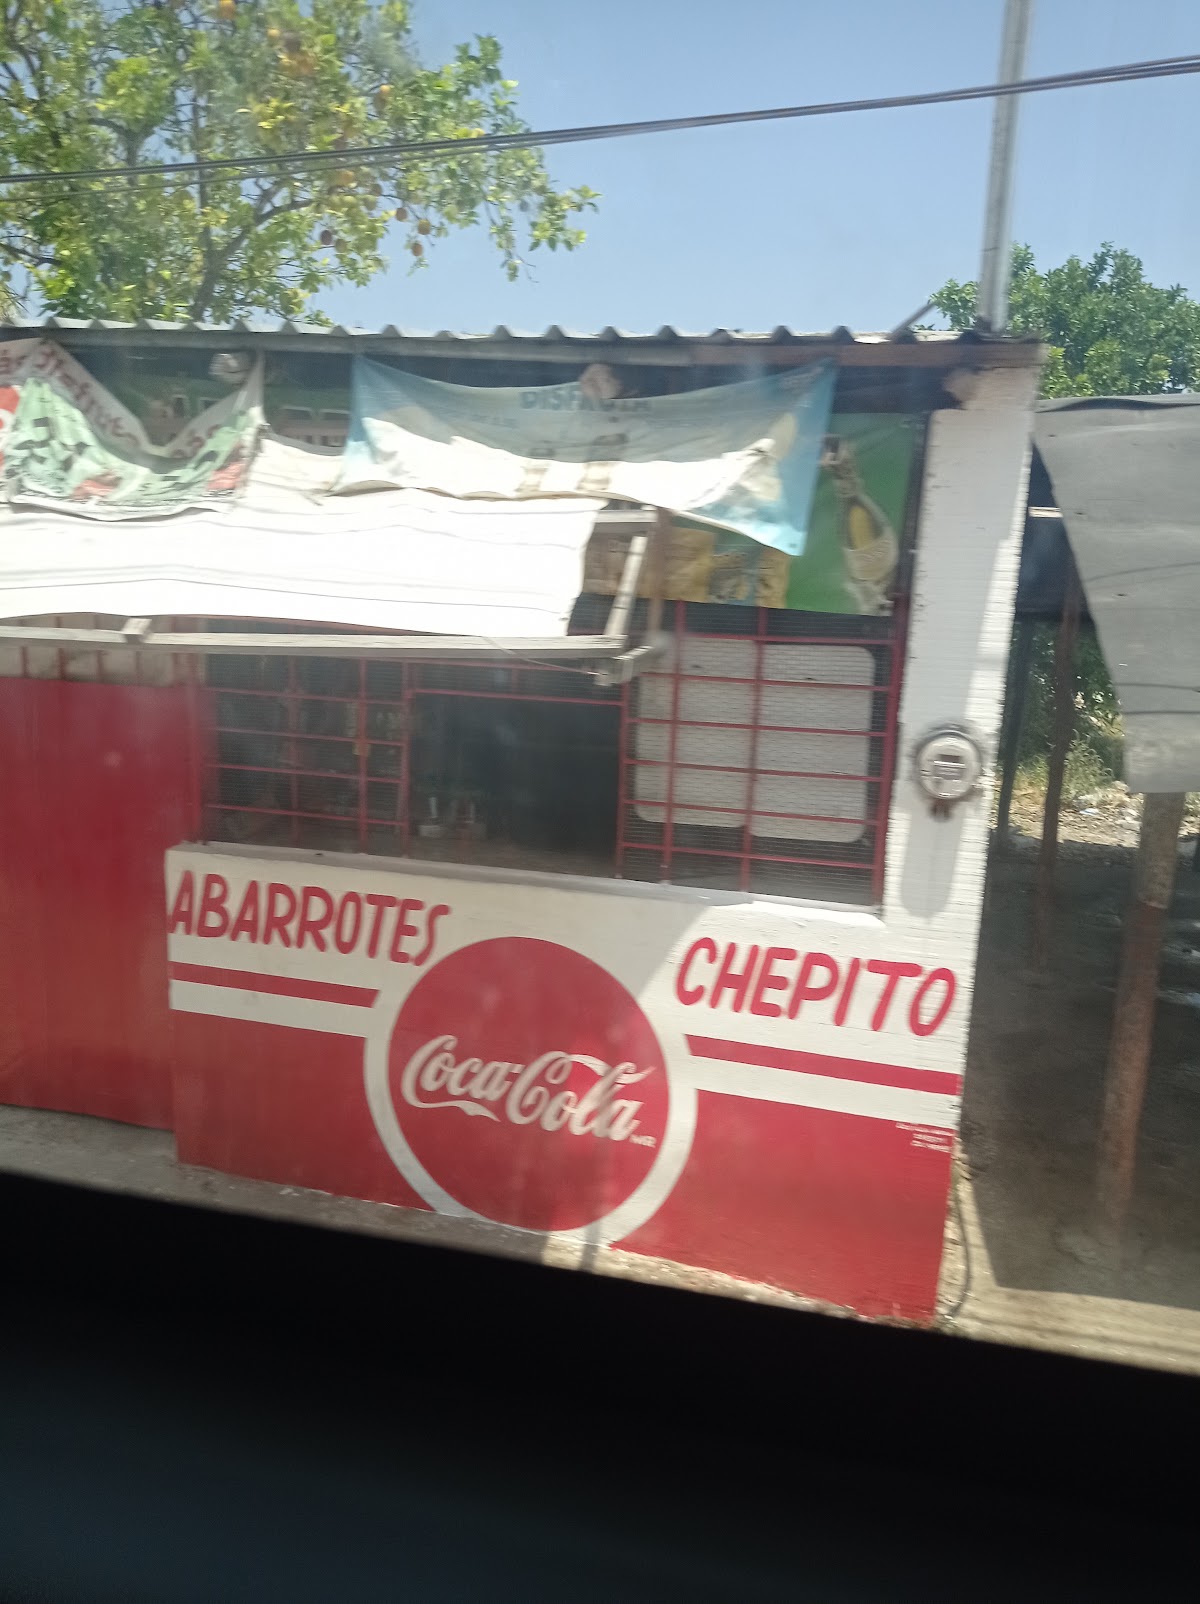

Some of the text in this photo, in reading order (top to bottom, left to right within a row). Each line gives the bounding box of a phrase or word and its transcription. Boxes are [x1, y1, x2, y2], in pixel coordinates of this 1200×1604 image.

[169, 869, 451, 967] ABARROTES
[675, 937, 957, 1037] CHEPITO
[402, 1034, 655, 1142] Coca-Cola
